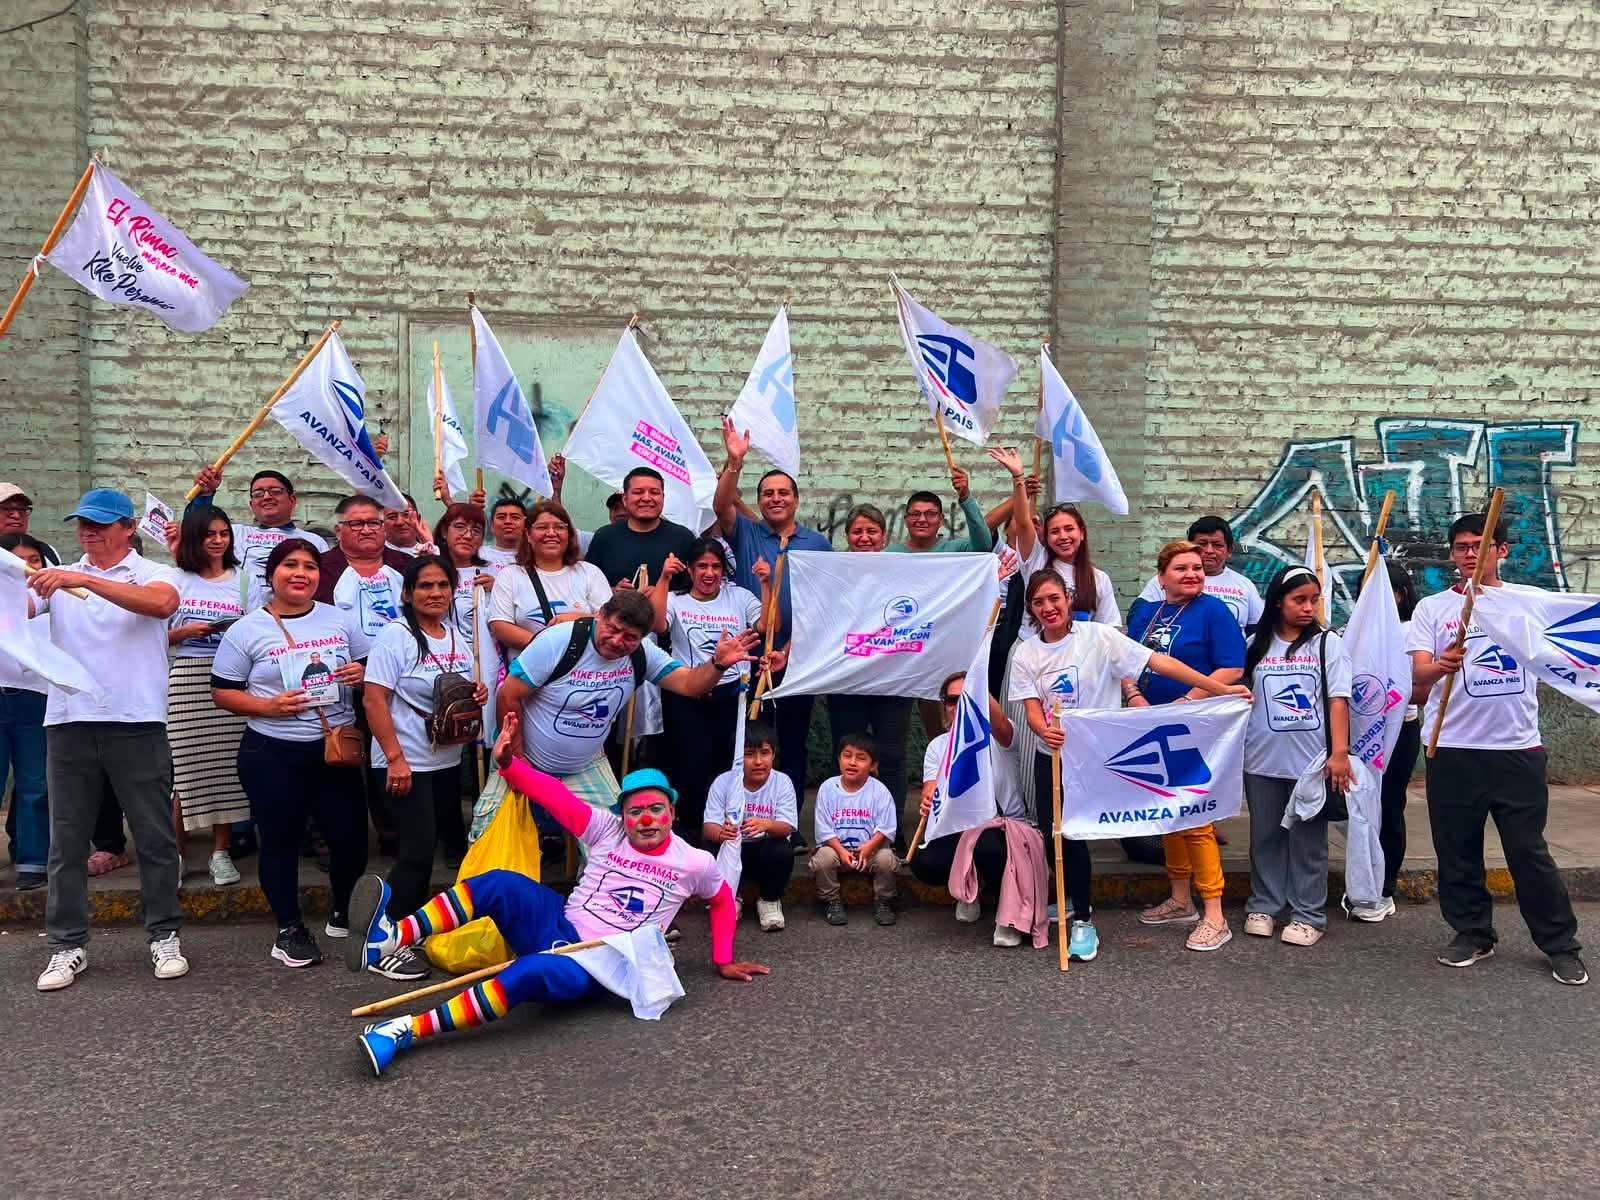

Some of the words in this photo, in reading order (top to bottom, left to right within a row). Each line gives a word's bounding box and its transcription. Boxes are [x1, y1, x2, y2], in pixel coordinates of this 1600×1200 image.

[83, 250, 115, 282] Kike
[112, 241, 144, 273] Vuelve
[141, 250, 177, 276] merece
[300, 411, 353, 460] AVANZA
[654, 445, 686, 468] AVANZA
[909, 631, 931, 641] CON
[1473, 678, 1504, 687] AVANZA
[1098, 807, 1174, 825] AVANZA
[607, 850, 631, 868] KIKE
[630, 861, 680, 882] PERAMÁS
